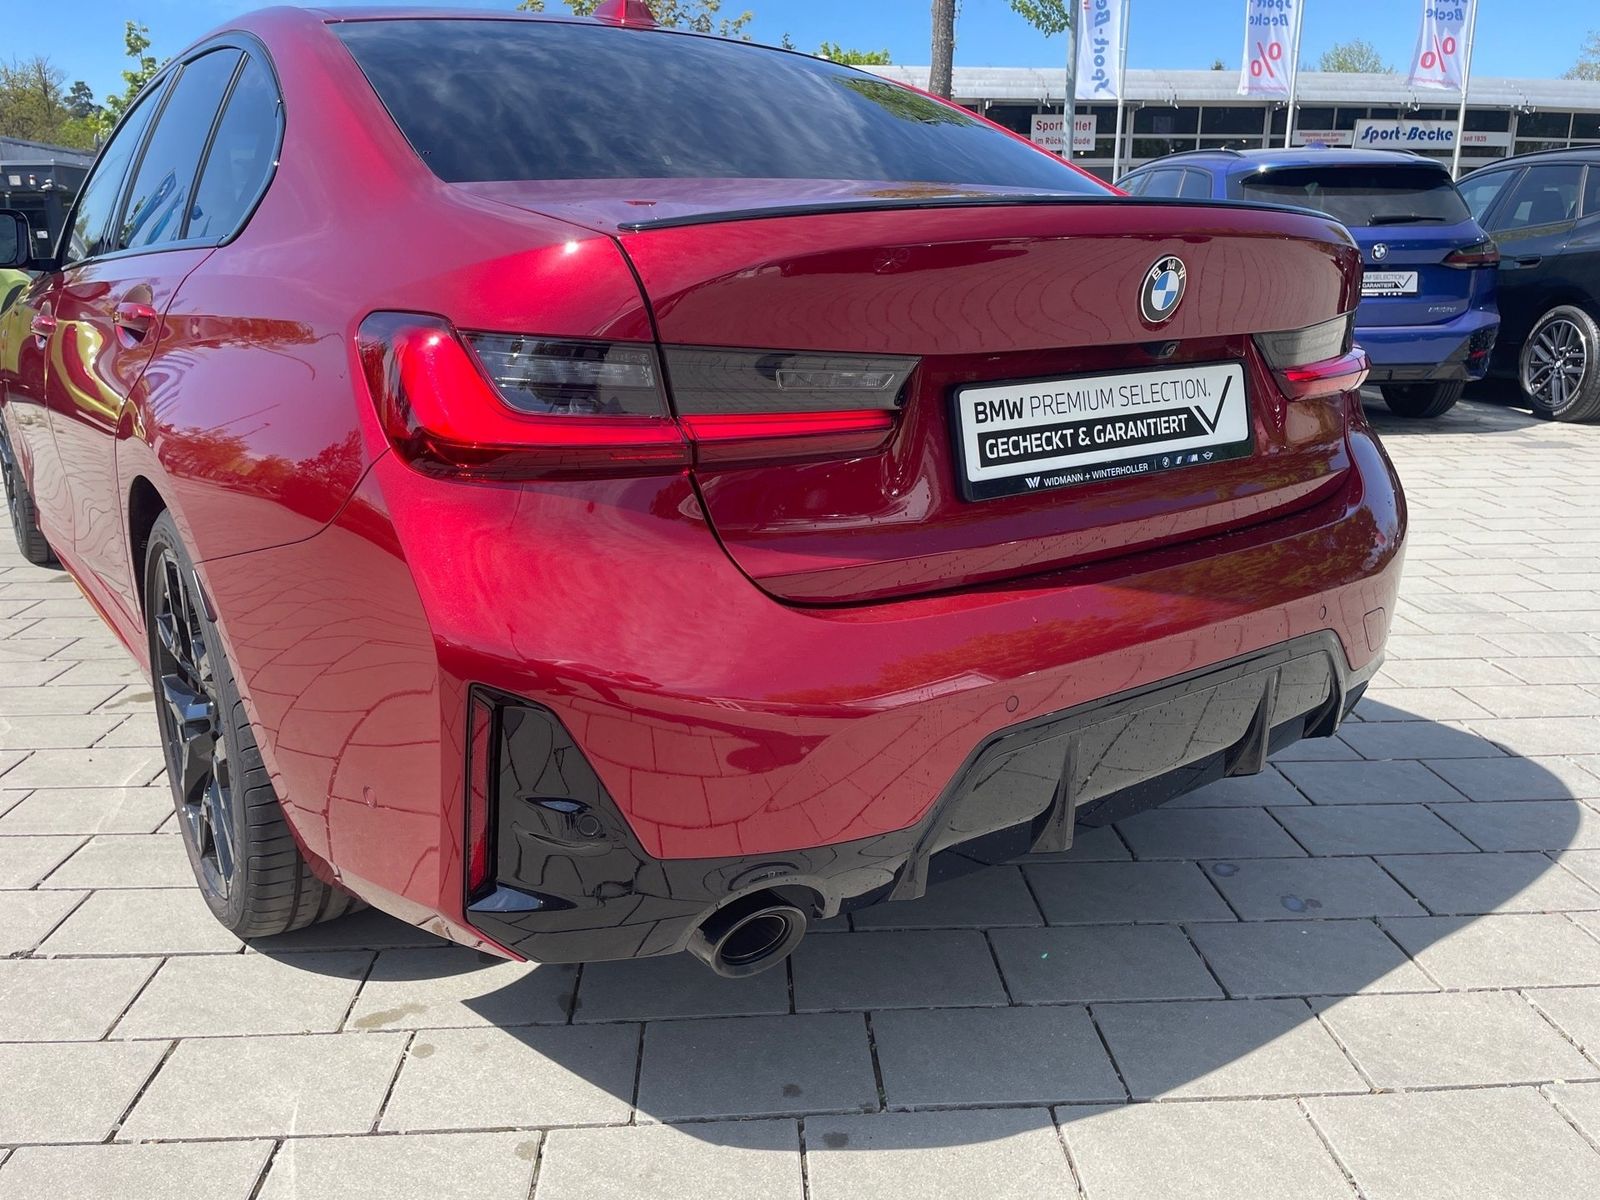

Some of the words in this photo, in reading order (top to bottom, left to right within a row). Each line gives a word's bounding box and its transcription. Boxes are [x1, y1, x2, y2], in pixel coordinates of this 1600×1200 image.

[1035, 120, 1092, 133] Sporttlet
[1361, 126, 1454, 143] Sport-Becke
[1151, 259, 1186, 280] BMW
[974, 397, 1024, 424] BMW
[1029, 387, 1115, 418] PREMIUM
[1118, 378, 1211, 407] SELECTION.
[985, 428, 1074, 460] GECHECKT
[1078, 427, 1091, 446] &
[1093, 414, 1188, 444] GARANTIERT
[1043, 474, 1084, 487] WIDMANN
[1091, 462, 1149, 479] WINTERHOLLER
